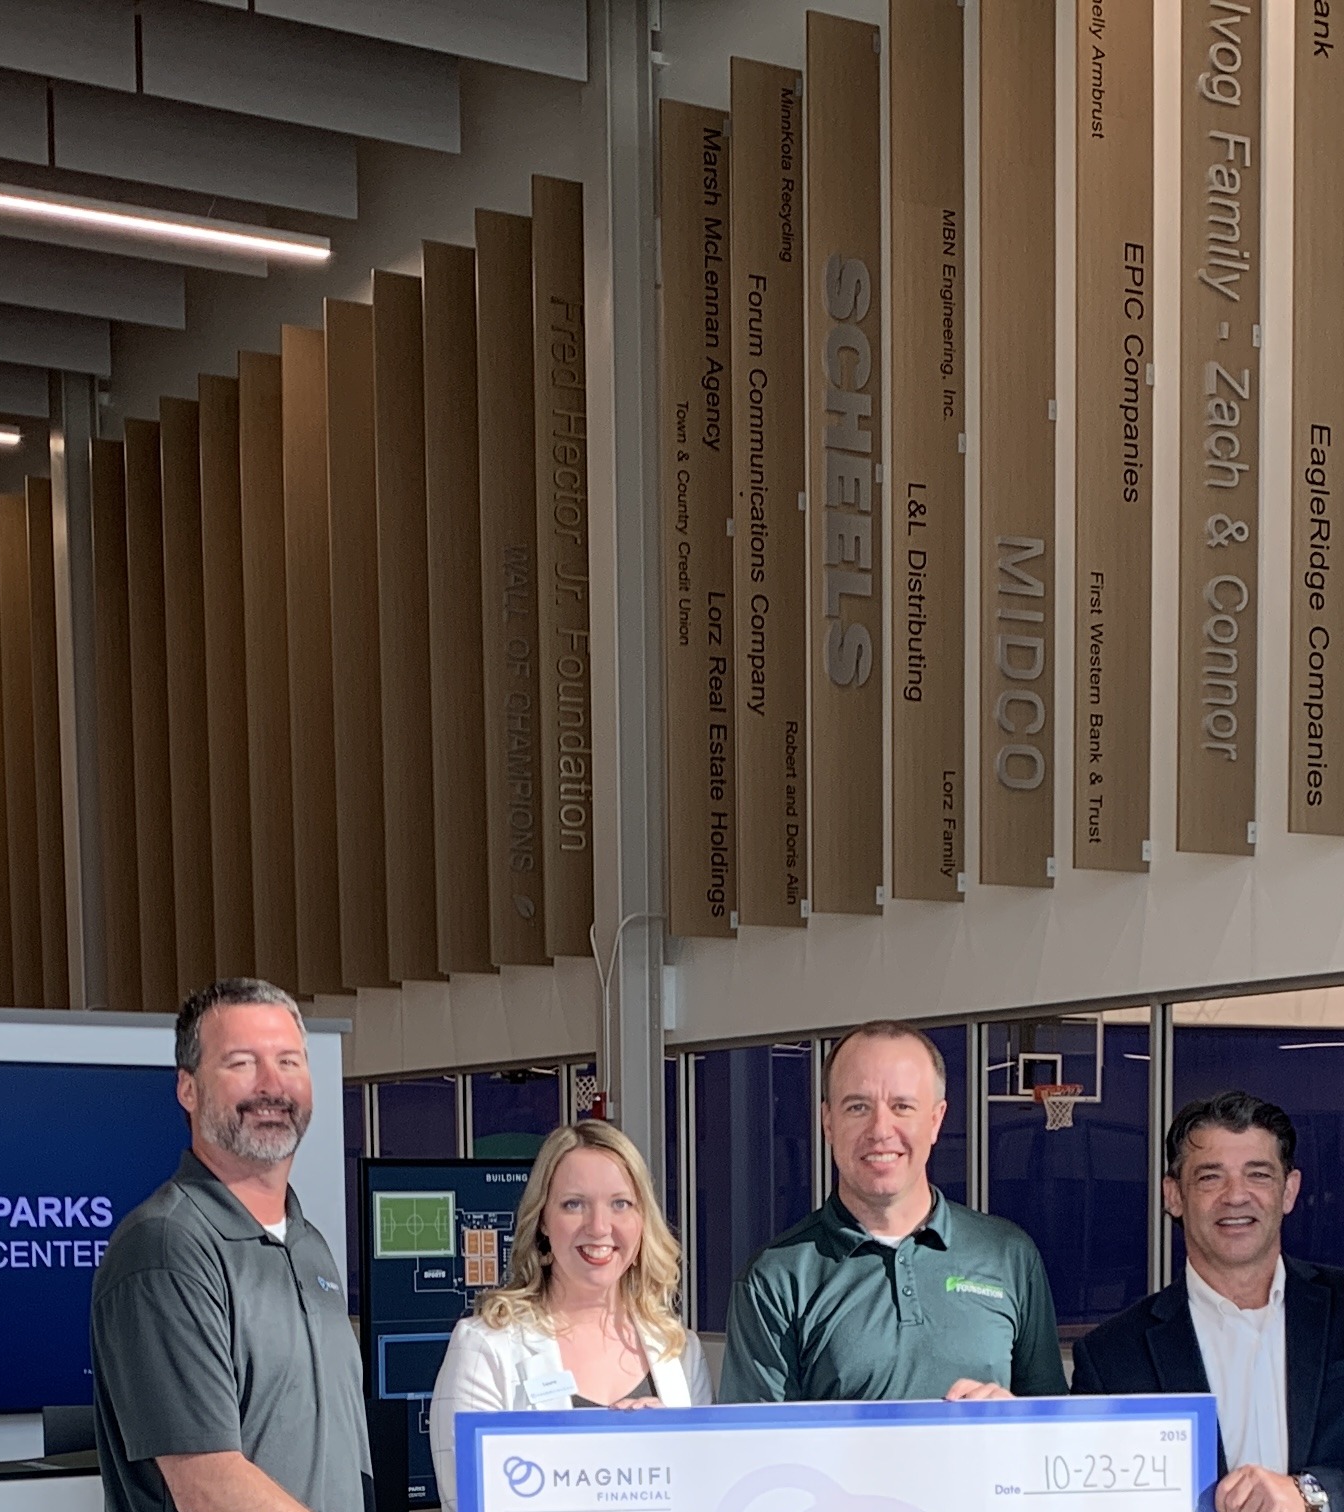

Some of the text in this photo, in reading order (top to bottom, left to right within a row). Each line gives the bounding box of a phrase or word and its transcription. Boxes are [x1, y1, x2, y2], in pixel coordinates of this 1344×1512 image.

[1090, 44, 1106, 140] Armbrust
[778, 87, 794, 262] MinnKota Recycling
[941, 209, 956, 256] MBN
[1197, 128, 1251, 301] Family
[701, 127, 726, 452] Marsh McLennan Agency
[941, 389, 956, 421] Inc.
[1119, 243, 1145, 504] EPIC Companies
[1205, 361, 1251, 489] Zach
[675, 401, 692, 646] Town & Country Credit Union
[746, 274, 770, 717] Forum Communications Company
[821, 251, 874, 689] SCHEELS
[1205, 512, 1250, 549] &
[551, 294, 593, 851] Fred Hector Jr. Foundation
[903, 482, 928, 703] L&L Distributing
[1303, 423, 1332, 807] EagleRidge Companies
[503, 543, 535, 874] WALL OF CHAMPIONS
[994, 535, 1046, 790] MIDCO
[1088, 571, 1105, 844] First Western Bank & Trust
[1200, 575, 1250, 762] Connor
[707, 591, 730, 918] Lorz Real Estate Holdings
[785, 721, 799, 778] Robert
[785, 785, 799, 817] and
[939, 770, 956, 878] Lorz Family
[786, 823, 799, 868] Doris
[485, 1173, 528, 1183] BUILDING
[552, 1467, 672, 1488] MAGNIFI
[596, 1490, 671, 1502] FINANCIAL
[994, 1484, 1022, 1497] Date
[1043, 1453, 1169, 1490] 10-23-24
[1159, 1430, 1188, 1442] 2015
